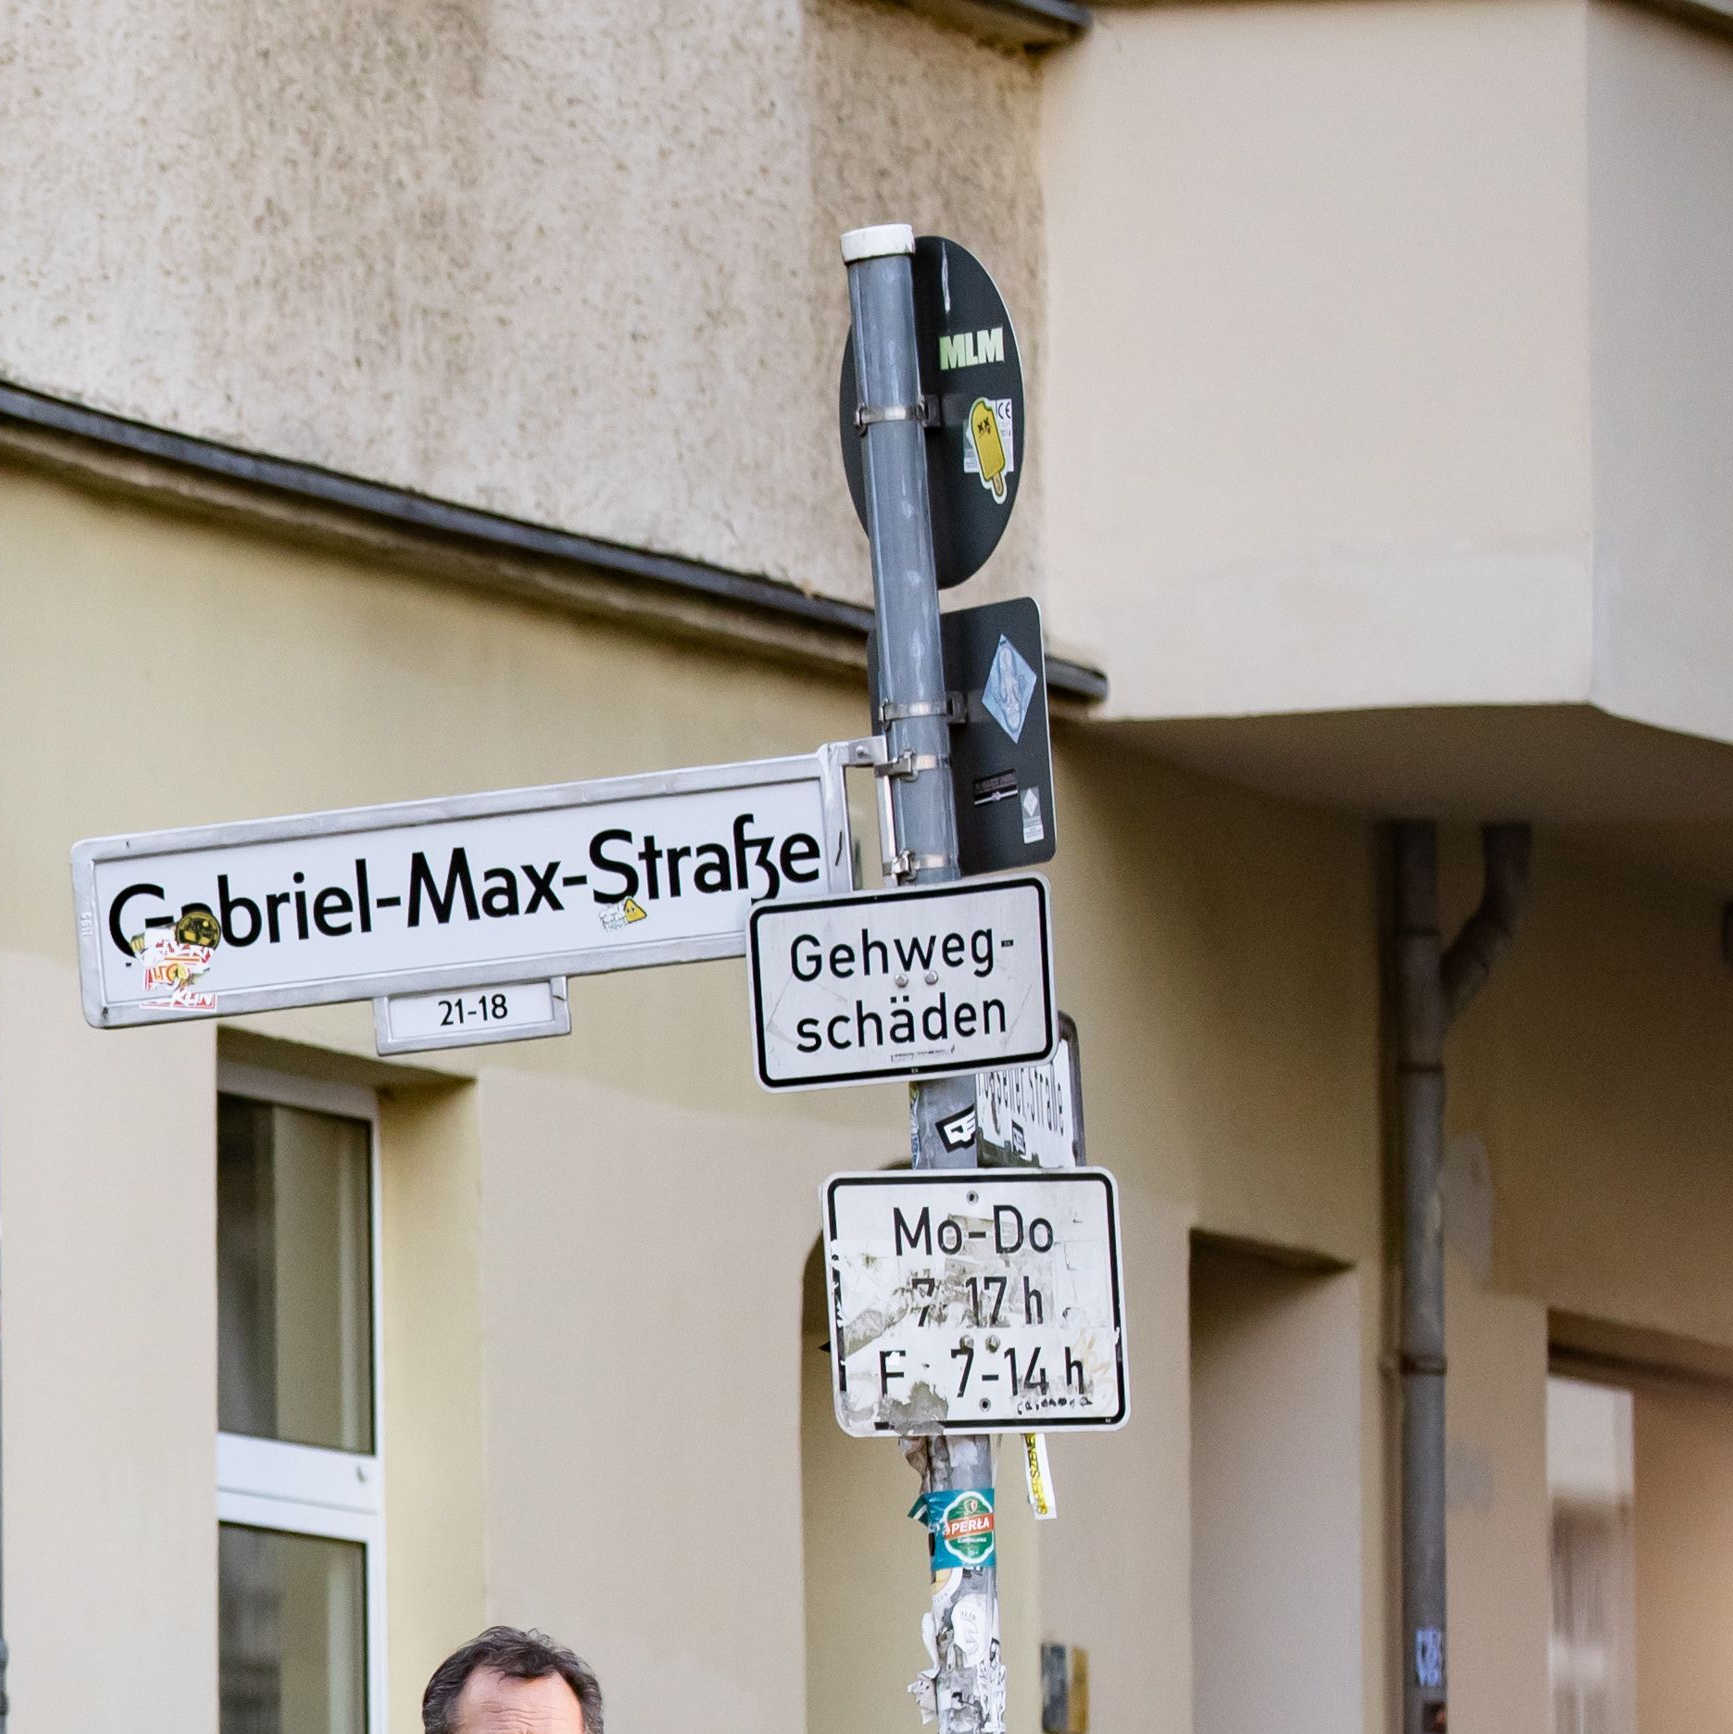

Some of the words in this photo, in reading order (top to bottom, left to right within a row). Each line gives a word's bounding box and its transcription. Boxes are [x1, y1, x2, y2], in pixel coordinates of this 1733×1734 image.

[939, 325, 1005, 371] MLM
[790, 928, 1015, 983] Gehweg-
[438, 993, 509, 1028] 21-18
[795, 992, 1008, 1053] schäden
[892, 1204, 1054, 1257] Mo-Do
[1023, 1275, 1044, 1325] h
[950, 1346, 1048, 1399] 7-14
[1064, 1345, 1086, 1395] h
[950, 1516, 991, 1536] PERŁA
